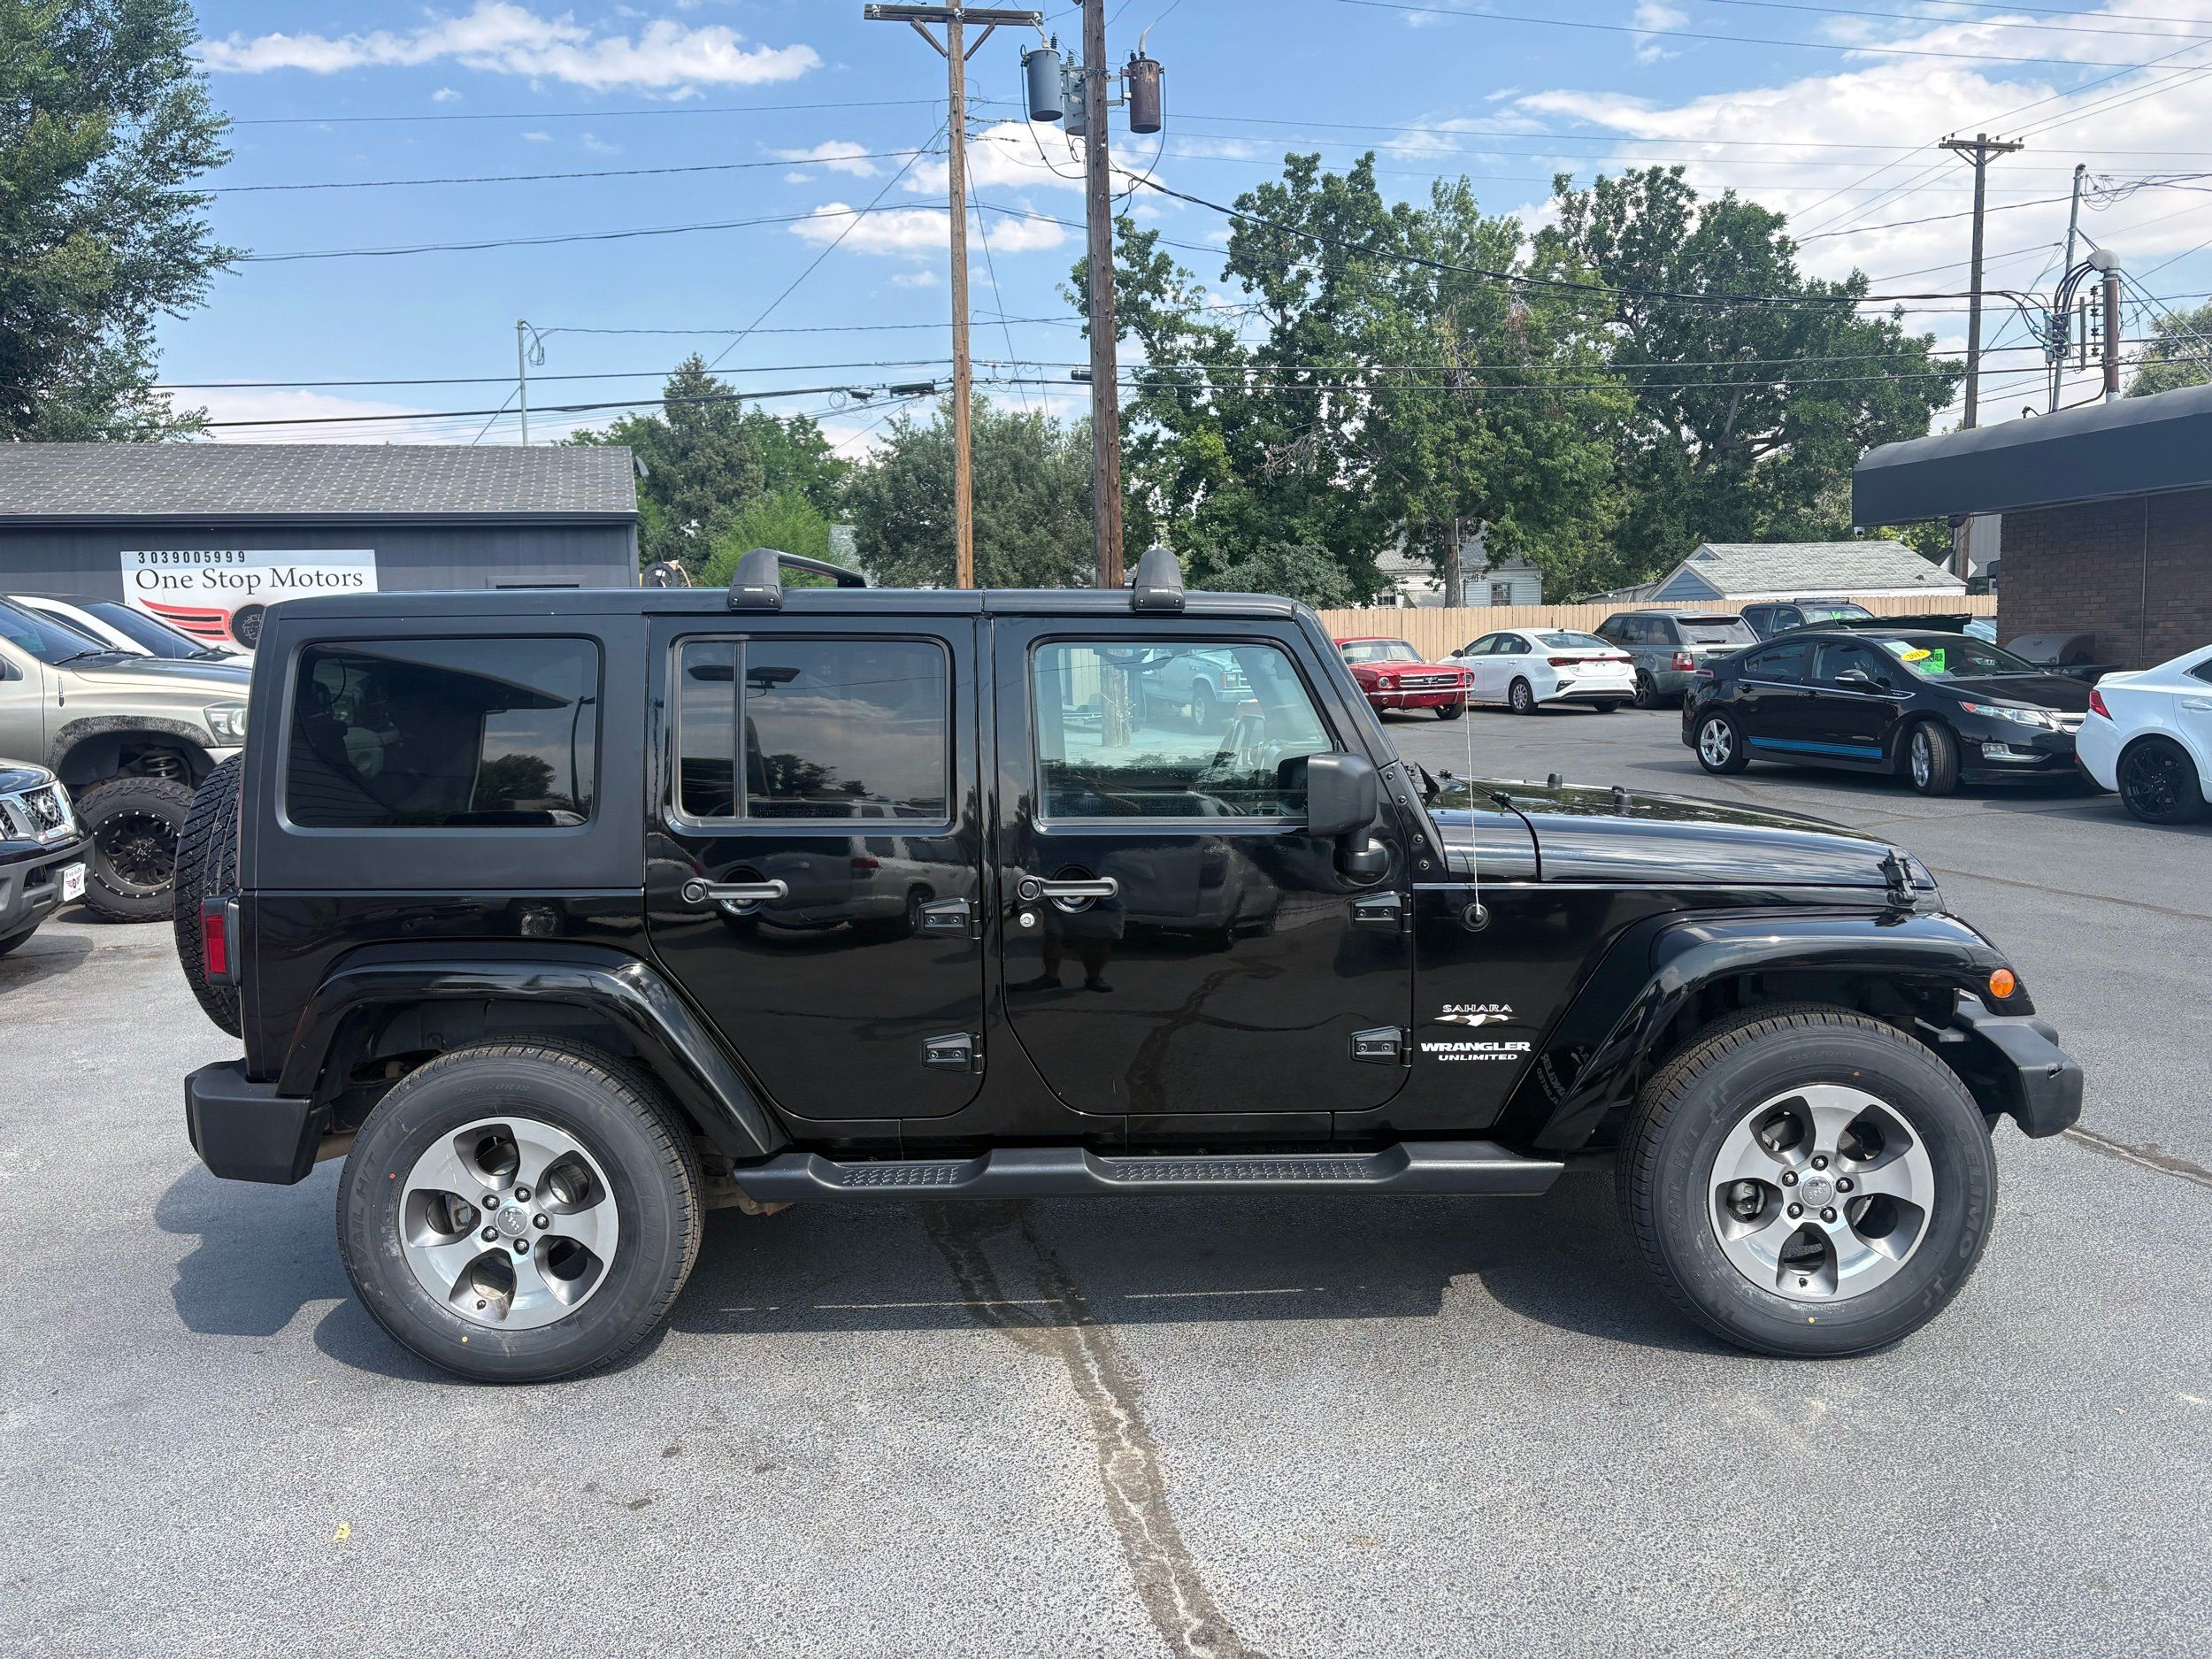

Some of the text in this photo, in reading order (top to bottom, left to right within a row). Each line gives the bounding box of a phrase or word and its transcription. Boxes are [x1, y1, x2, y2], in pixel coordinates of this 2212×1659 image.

[138, 551, 245, 564] 3039005999
[135, 567, 364, 595] One Stop Motors
[1907, 650, 1925, 660] 2015
[1442, 1003, 1513, 1013] SAHARA
[1420, 1041, 1532, 1052] WRANGLER
[1955, 1128, 1984, 1259] CELIMO
